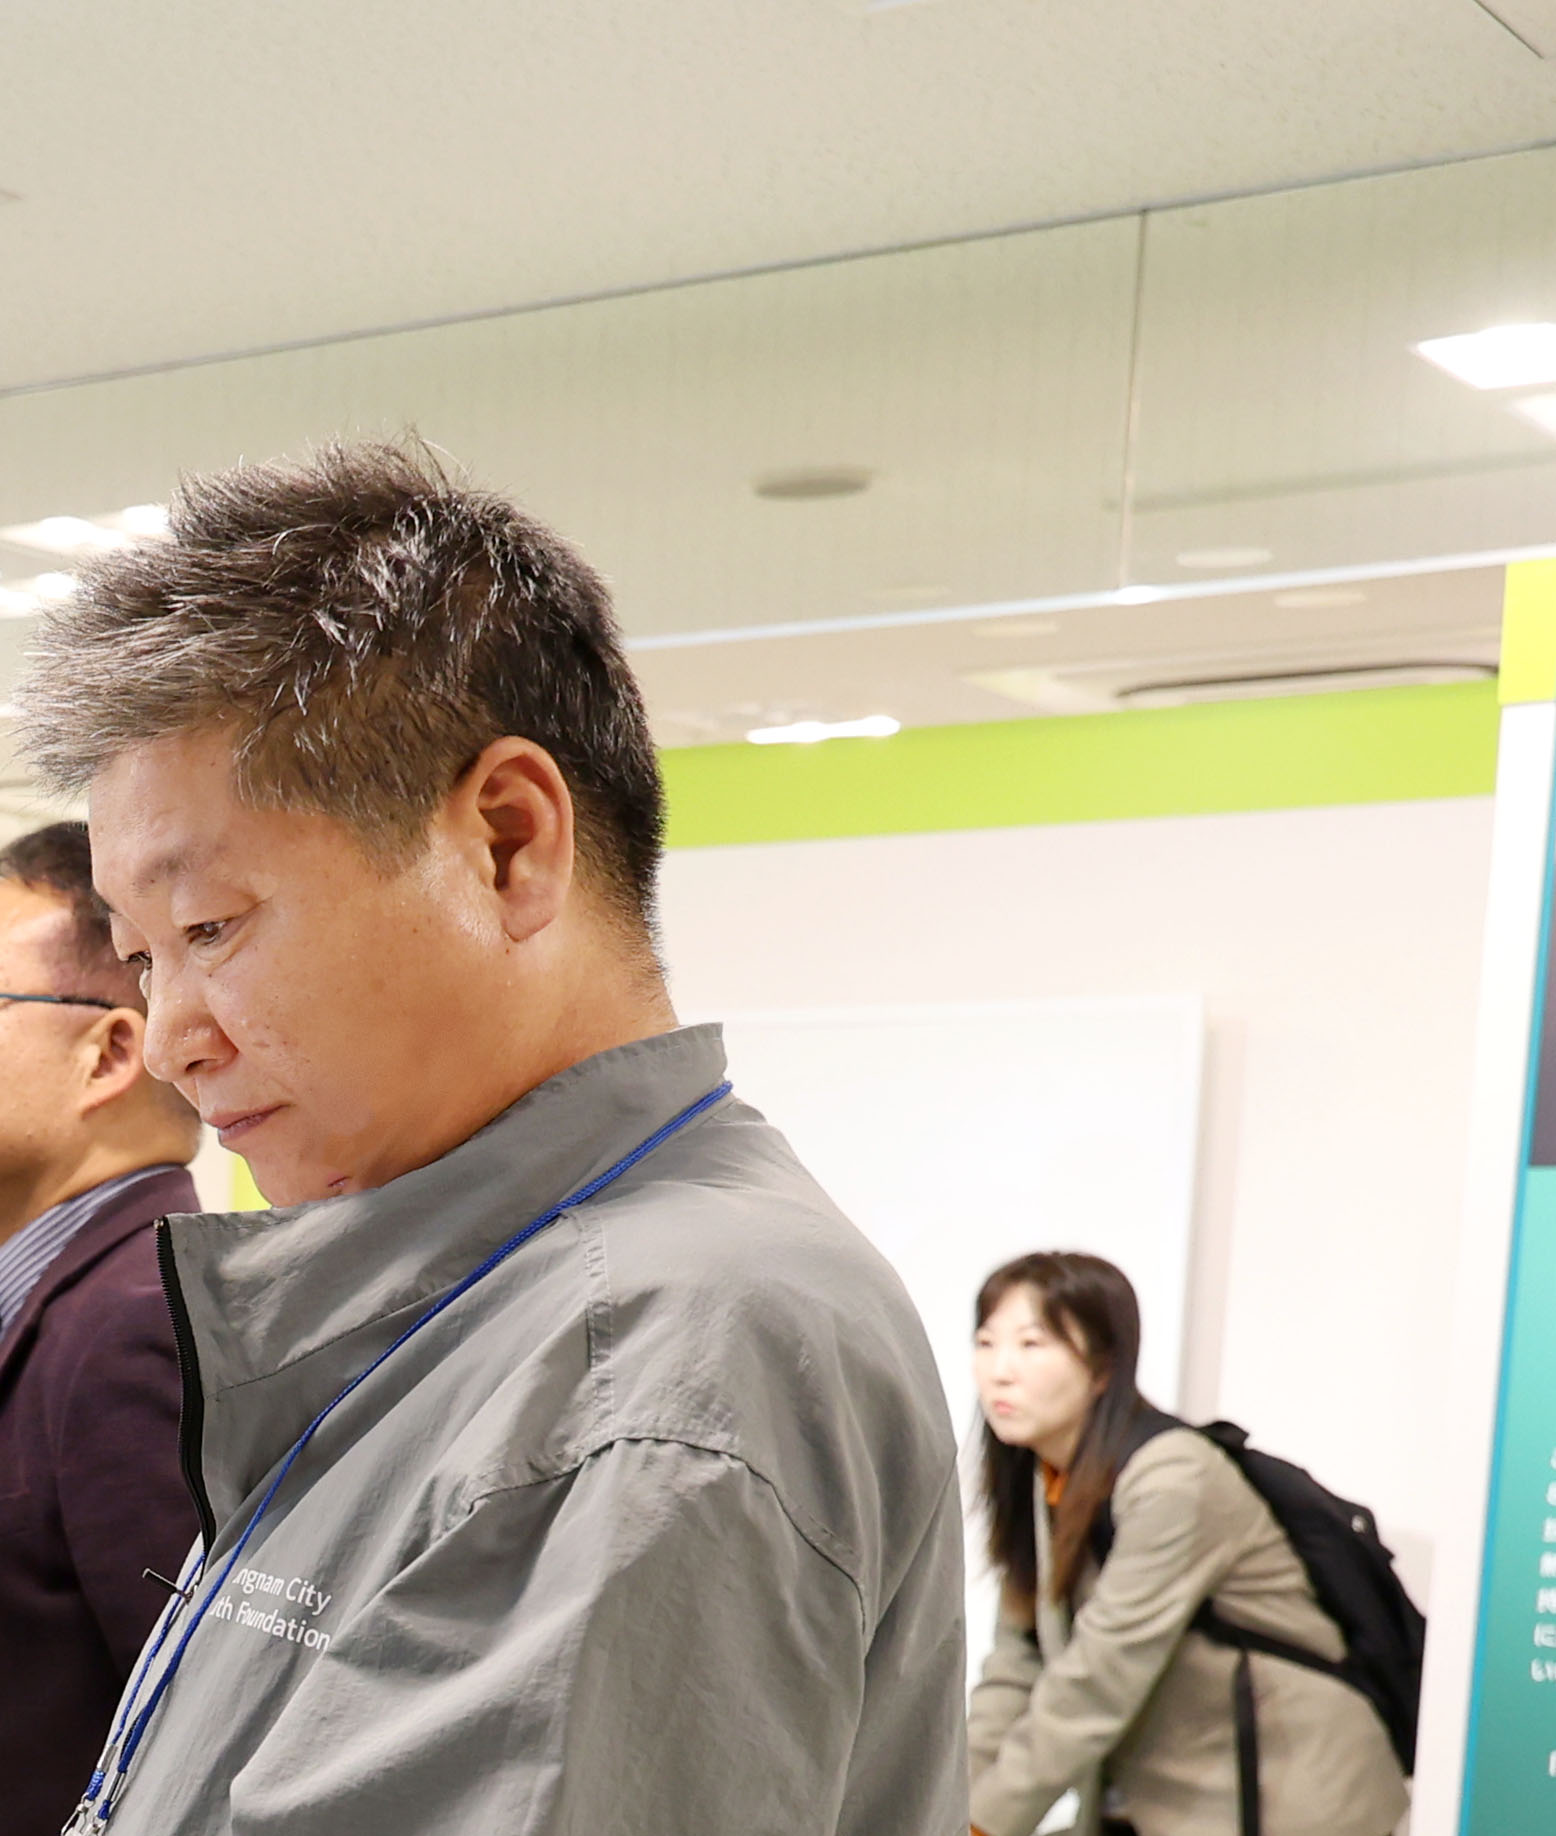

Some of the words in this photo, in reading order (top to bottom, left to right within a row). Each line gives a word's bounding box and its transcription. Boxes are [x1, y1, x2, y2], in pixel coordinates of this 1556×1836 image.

[232, 1568, 284, 1595] ngnam
[286, 1577, 332, 1617] City
[236, 1601, 331, 1651] Foundation
